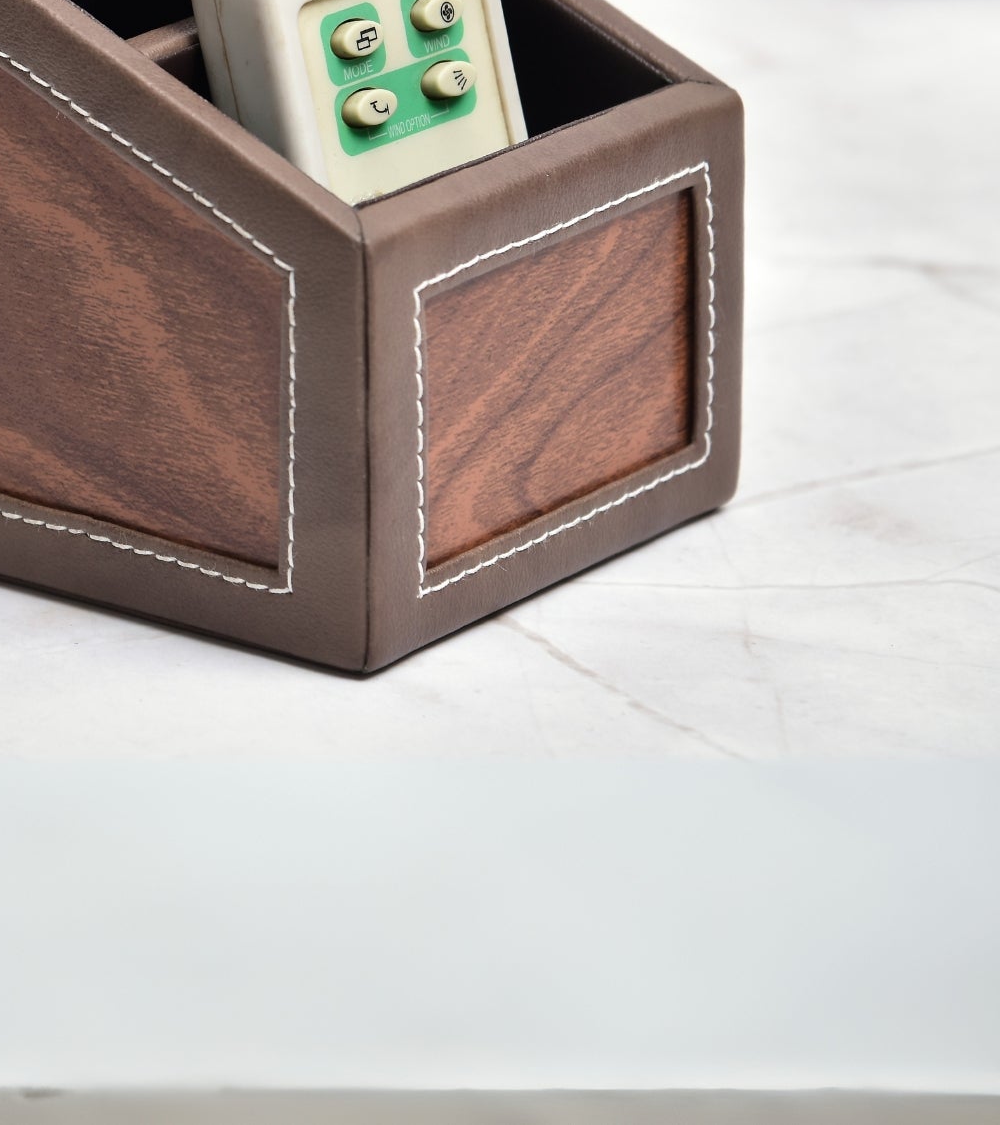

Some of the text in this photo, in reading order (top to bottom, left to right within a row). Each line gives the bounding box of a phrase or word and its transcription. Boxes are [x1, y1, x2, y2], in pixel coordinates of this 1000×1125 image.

[423, 34, 451, 53] WIND
[342, 59, 374, 81] MODE
[387, 113, 432, 139] WIND OPTION
